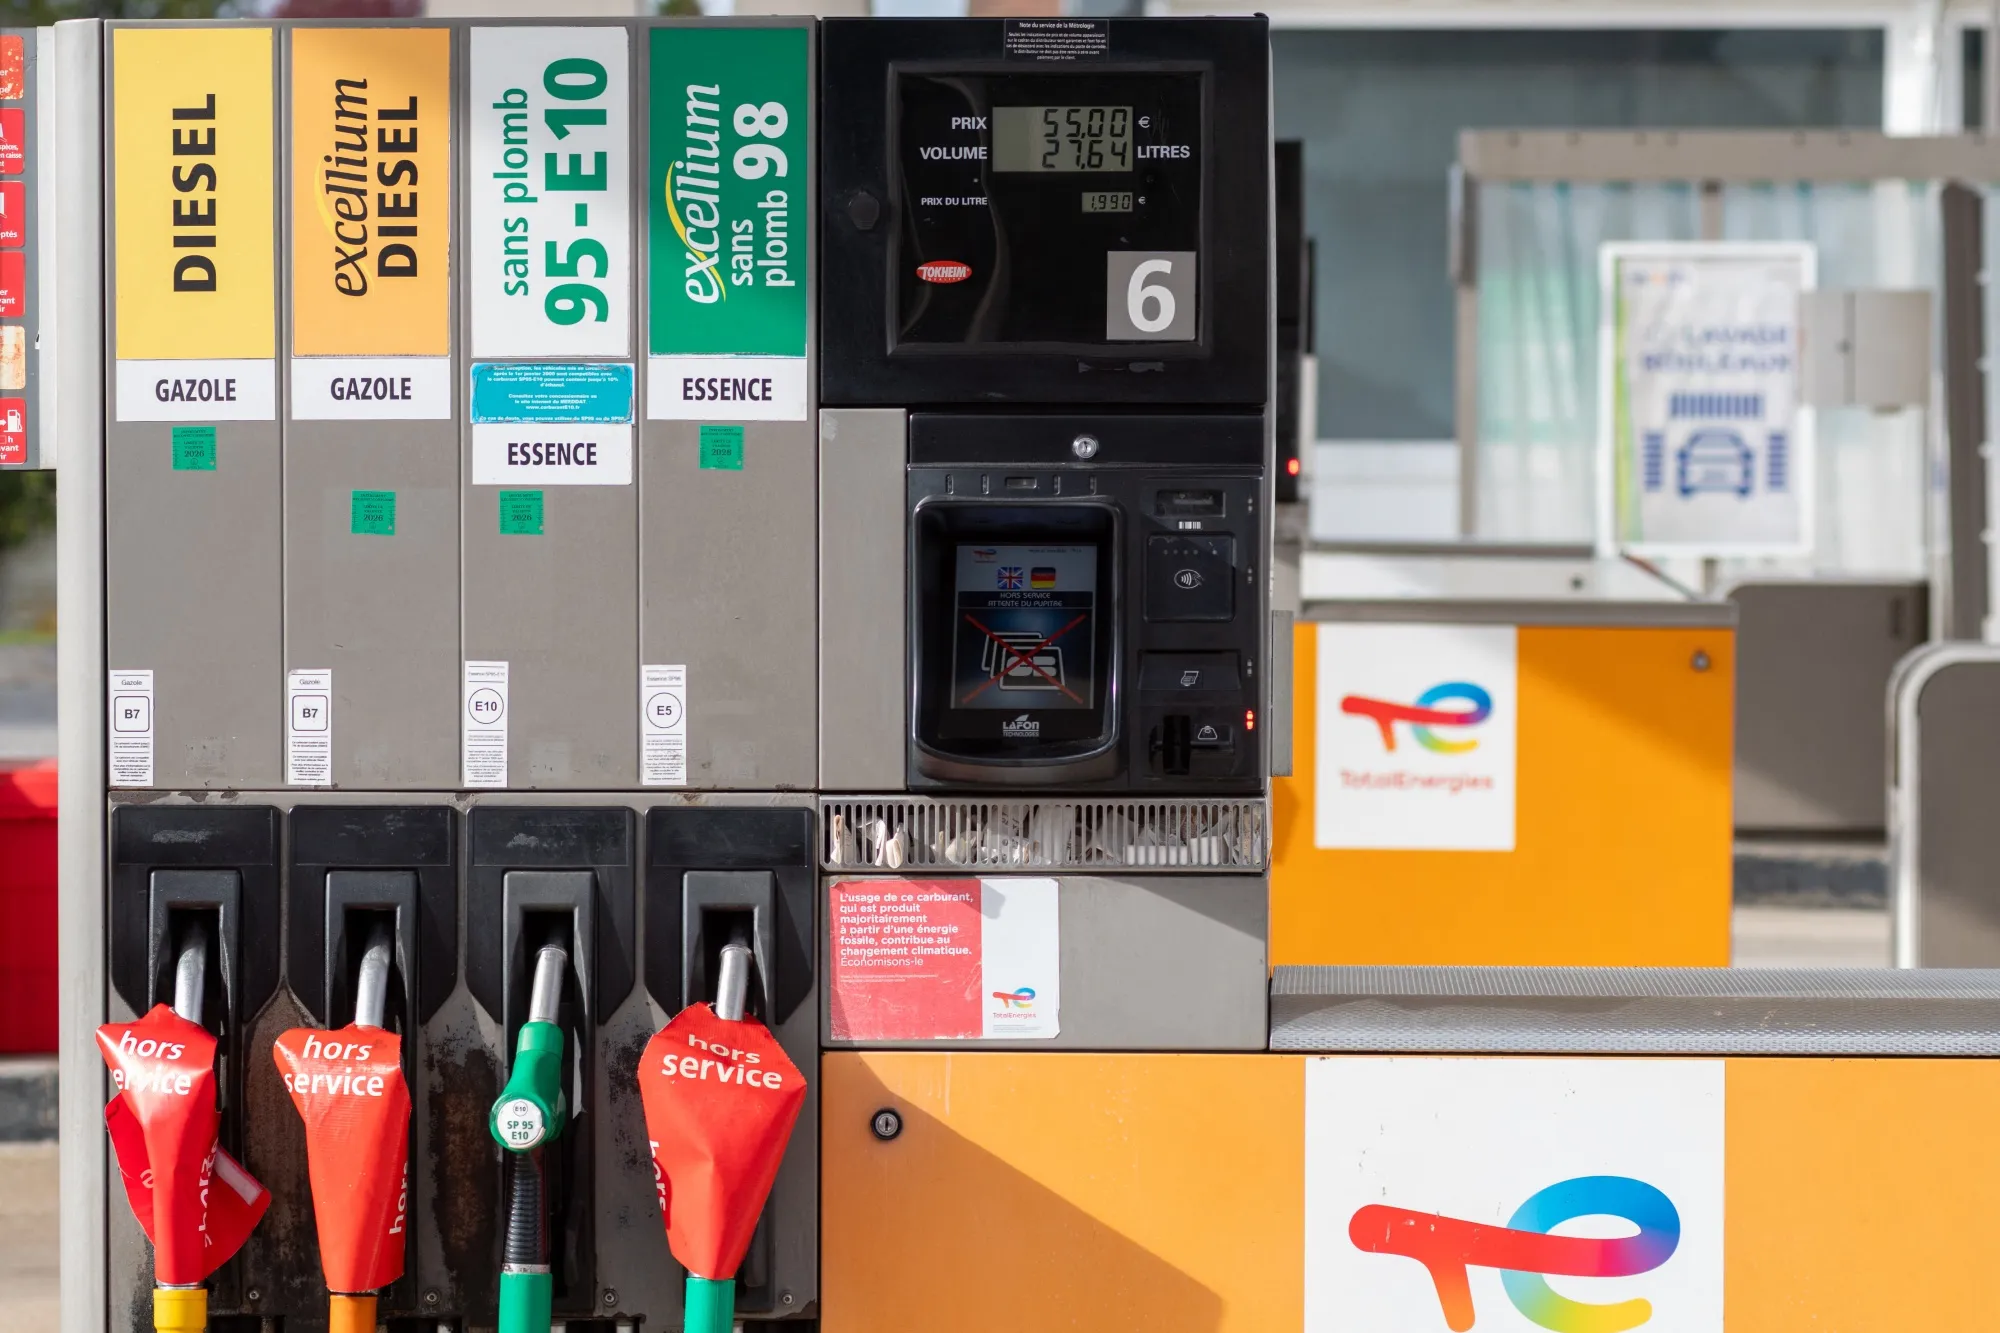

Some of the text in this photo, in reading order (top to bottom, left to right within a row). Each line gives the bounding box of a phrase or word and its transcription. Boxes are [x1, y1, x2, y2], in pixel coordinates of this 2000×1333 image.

[952, 116, 987, 130] PRIX
[1044, 108, 1128, 138] 55,00
[1138, 116, 1150, 128] €
[920, 147, 988, 159] VOLUME
[1042, 140, 1127, 169] 27,64
[1137, 145, 1190, 158] LITRES
[172, 94, 216, 292] DIESEL
[324, 78, 368, 296] excellium
[377, 96, 418, 278] DIESEL
[493, 88, 538, 296] sans plomb
[674, 84, 720, 304] excellium
[733, 102, 795, 288] plomb 98
[921, 197, 987, 206] PRIX DU LITRE
[732, 219, 753, 286] sans
[917, 266, 966, 280] TOKHEIM
[1127, 258, 1176, 332] 6
[155, 379, 236, 402] GAZOLE
[331, 377, 412, 400] GAZOLE
[682, 378, 772, 401] ESSENCE
[508, 442, 597, 466] ESSENCE
[125, 709, 140, 719] B7
[303, 708, 318, 718] B7
[475, 701, 497, 711] E10
[657, 706, 672, 716] E5
[1003, 722, 1039, 730] LAFON
[1340, 769, 1493, 795] TotalEnergies
[884, 893, 898, 901] de
[917, 893, 973, 903] carburant,
[840, 904, 857, 914] qui
[880, 904, 920, 914] produit
[840, 914, 928, 924] majoritairement
[840, 925, 847, 934] à
[850, 926, 880, 936] partir
[917, 925, 959, 935] énergie
[840, 936, 878, 946] fossile,
[881, 936, 934, 944] contribue
[840, 946, 972, 957] changement climatique.
[841, 956, 924, 967] Économisons-le
[118, 1030, 185, 1060] hors
[302, 1035, 372, 1061] hors
[689, 1034, 760, 1064] hors
[661, 1054, 782, 1089] service
[111, 1067, 192, 1095] ervice
[507, 1121, 534, 1129] SP 95
[512, 1132, 528, 1140] E10
